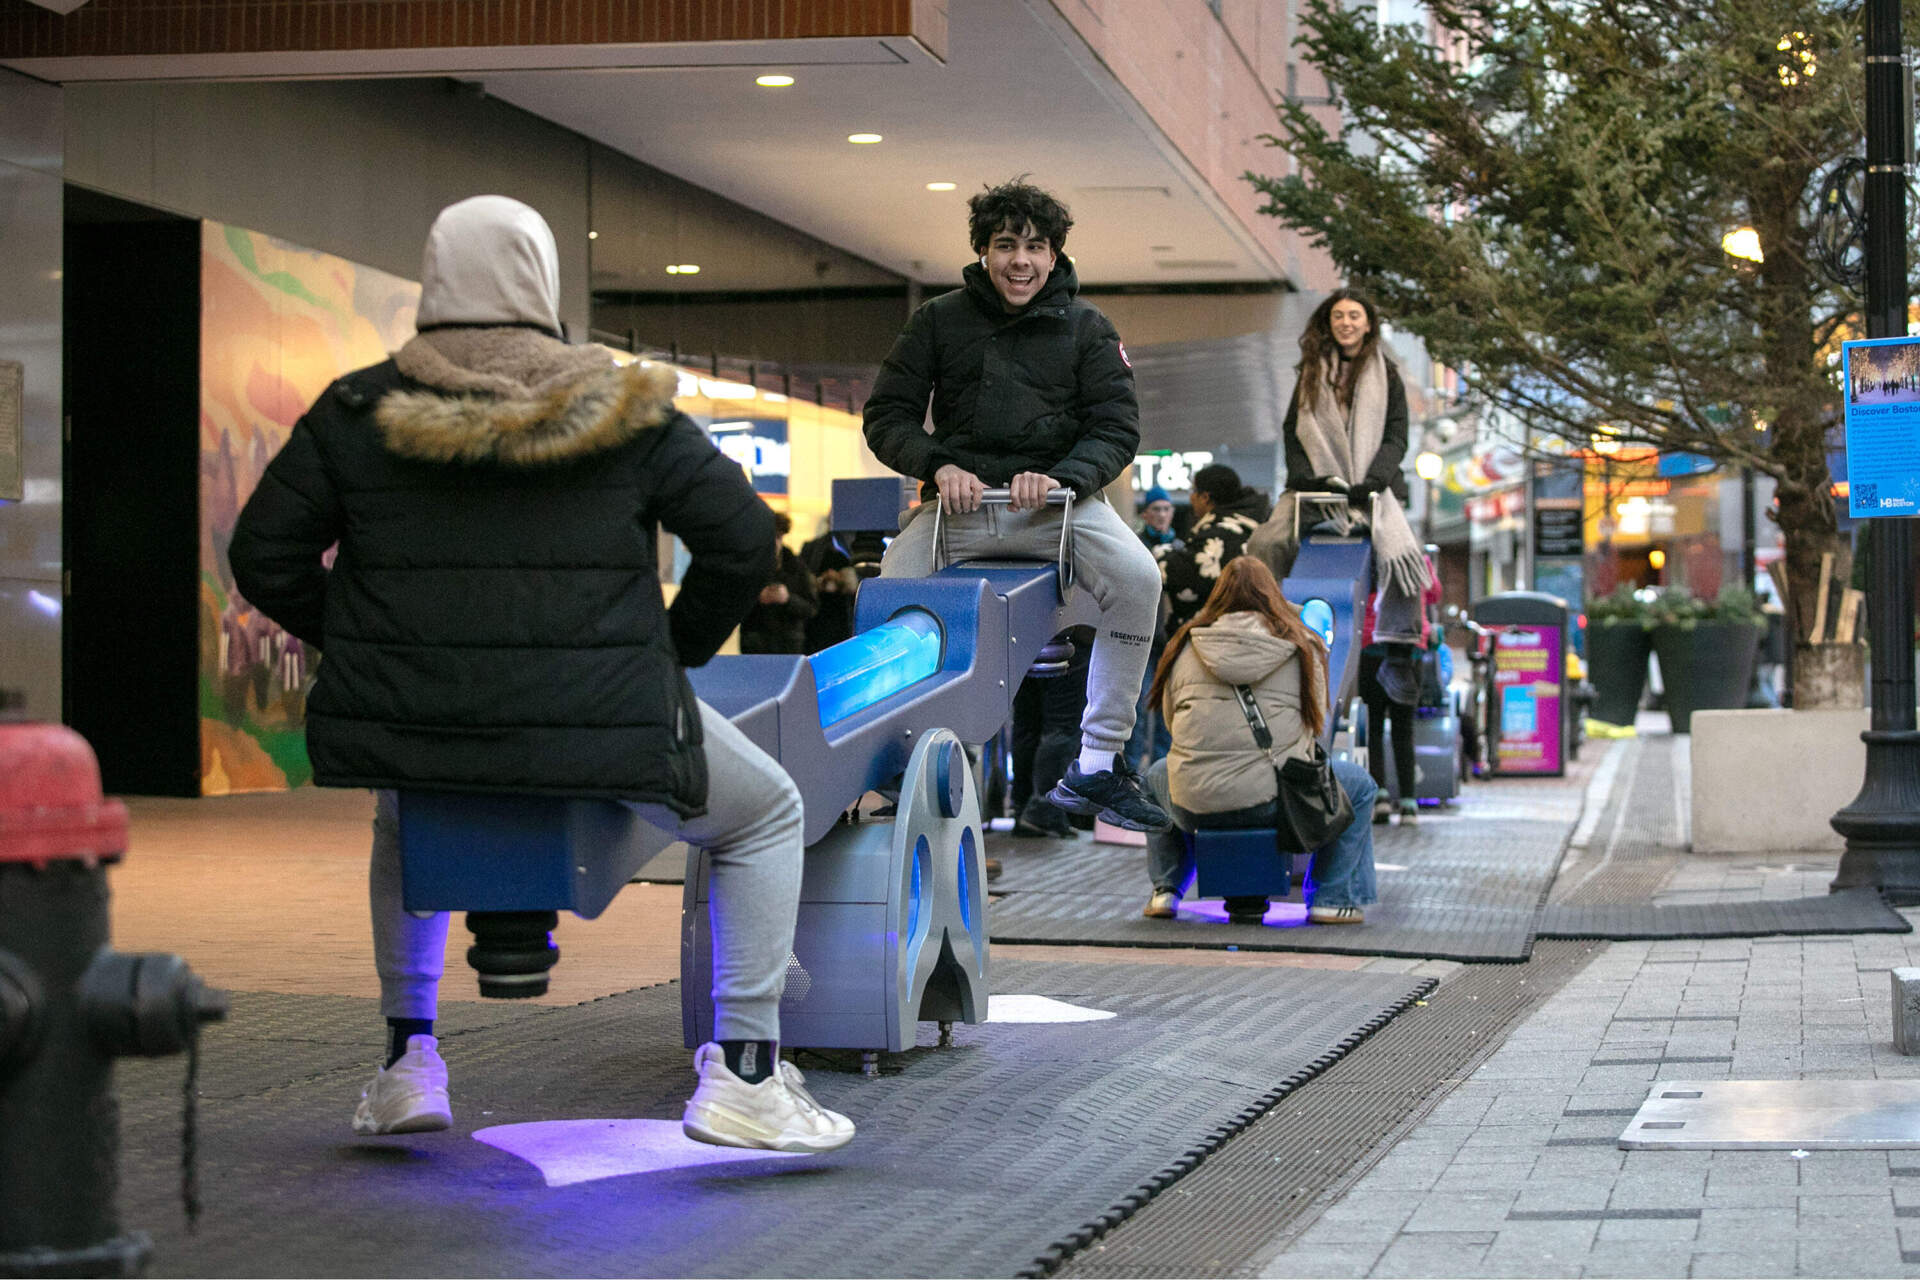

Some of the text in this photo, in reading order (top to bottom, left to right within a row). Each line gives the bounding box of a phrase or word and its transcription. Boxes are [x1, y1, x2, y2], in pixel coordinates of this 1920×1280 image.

[1851, 405, 1920, 417] Discover Bosto
[1132, 452, 1213, 491] T&T
